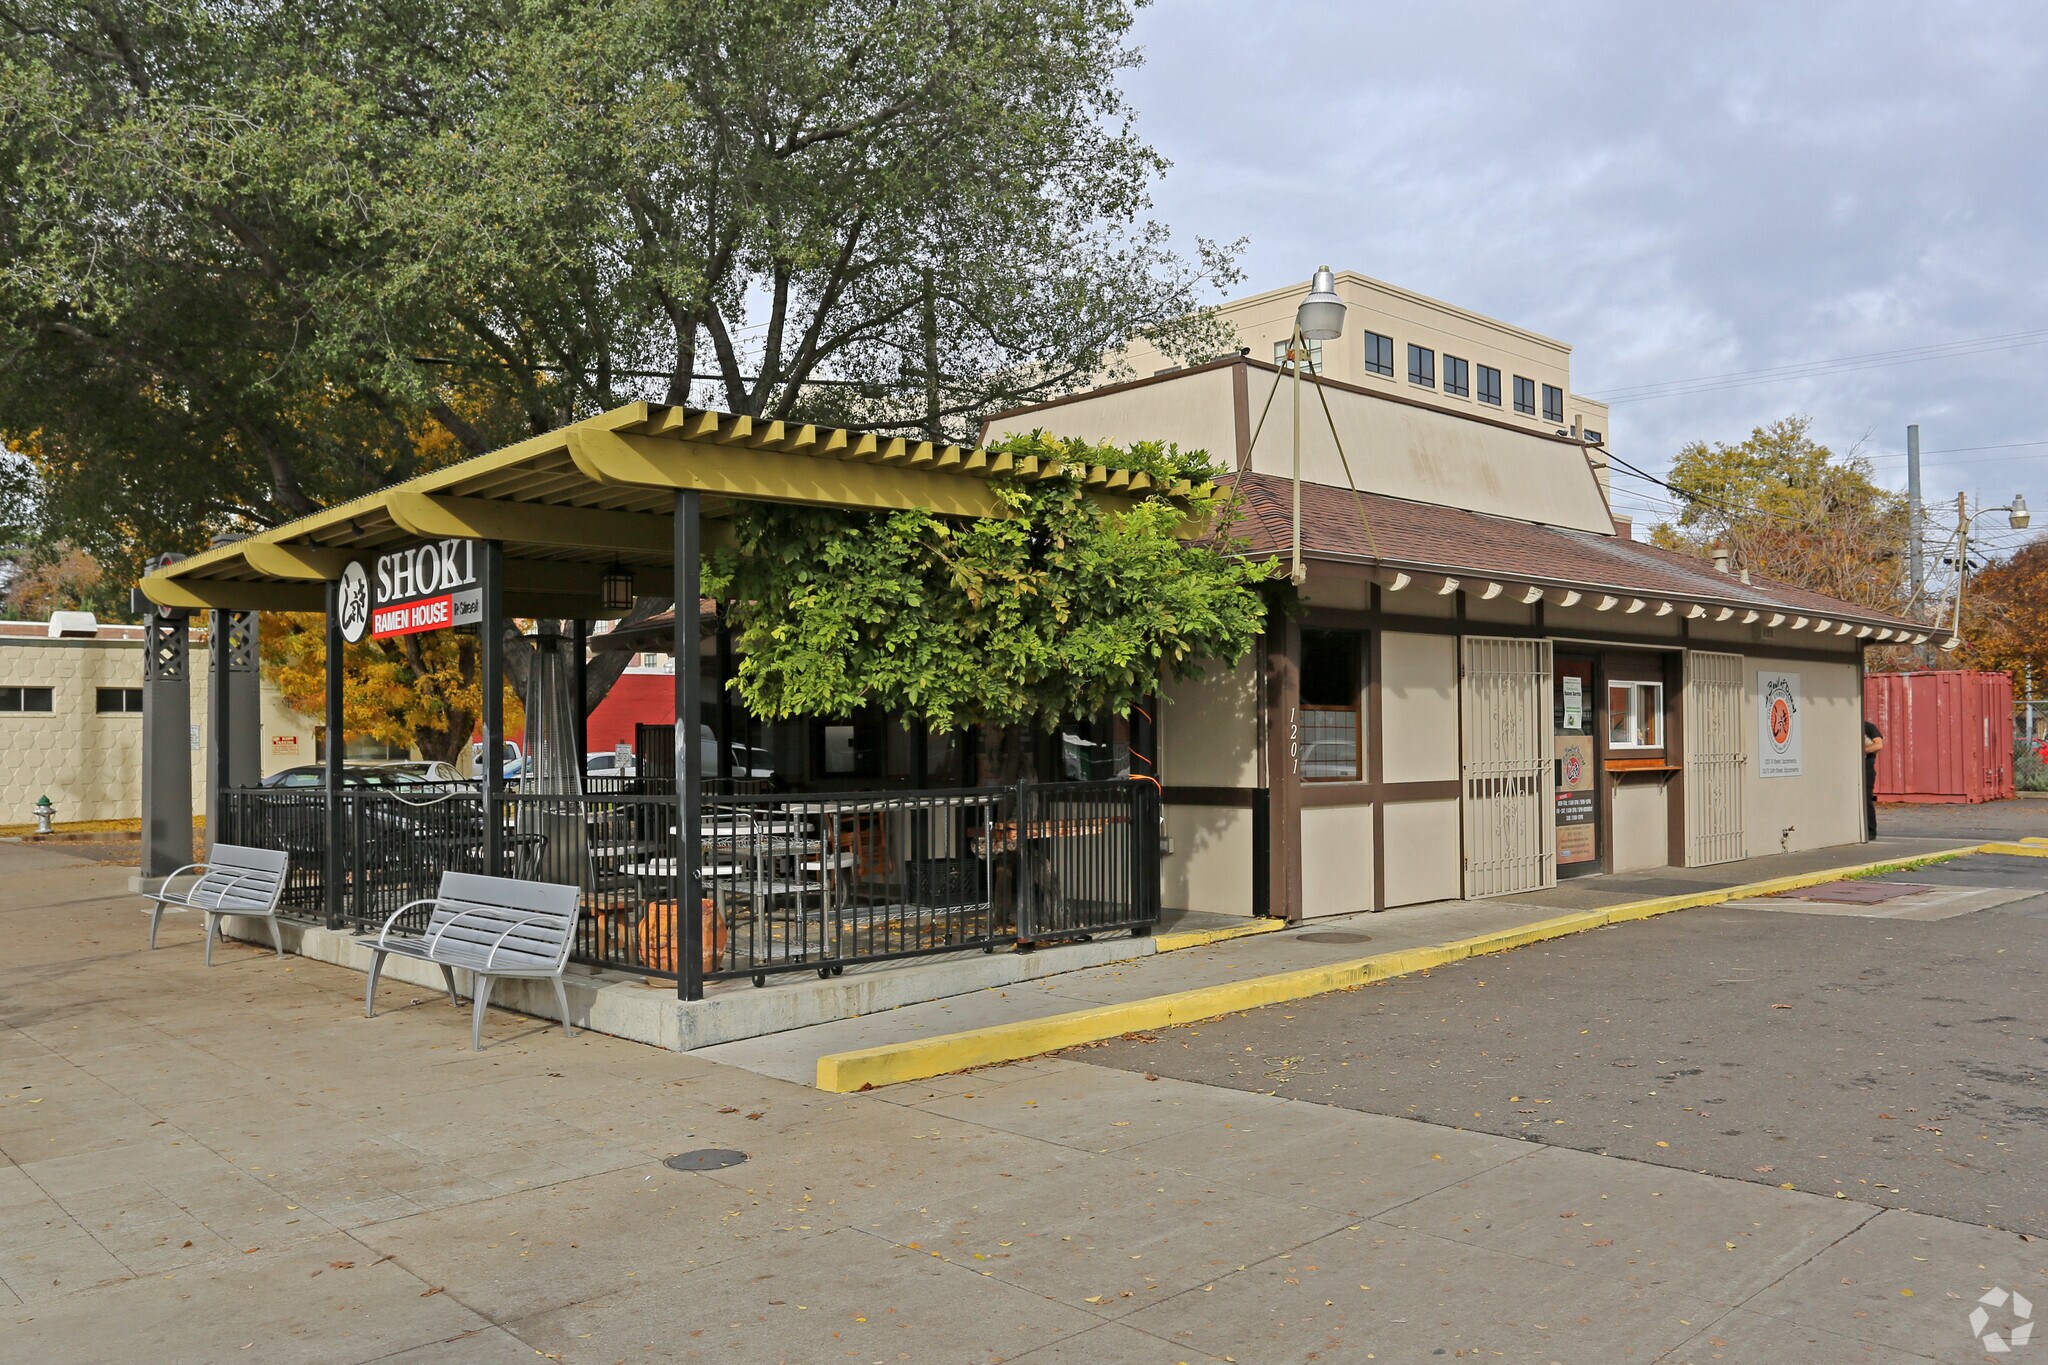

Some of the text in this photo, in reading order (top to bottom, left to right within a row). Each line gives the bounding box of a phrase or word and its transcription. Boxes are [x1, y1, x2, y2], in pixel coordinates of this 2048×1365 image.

[377, 539, 477, 603] SHOKI
[374, 601, 449, 633] RAMEN HOUSE
[460, 598, 479, 615] Street
[1290, 707, 1298, 774] 1201
